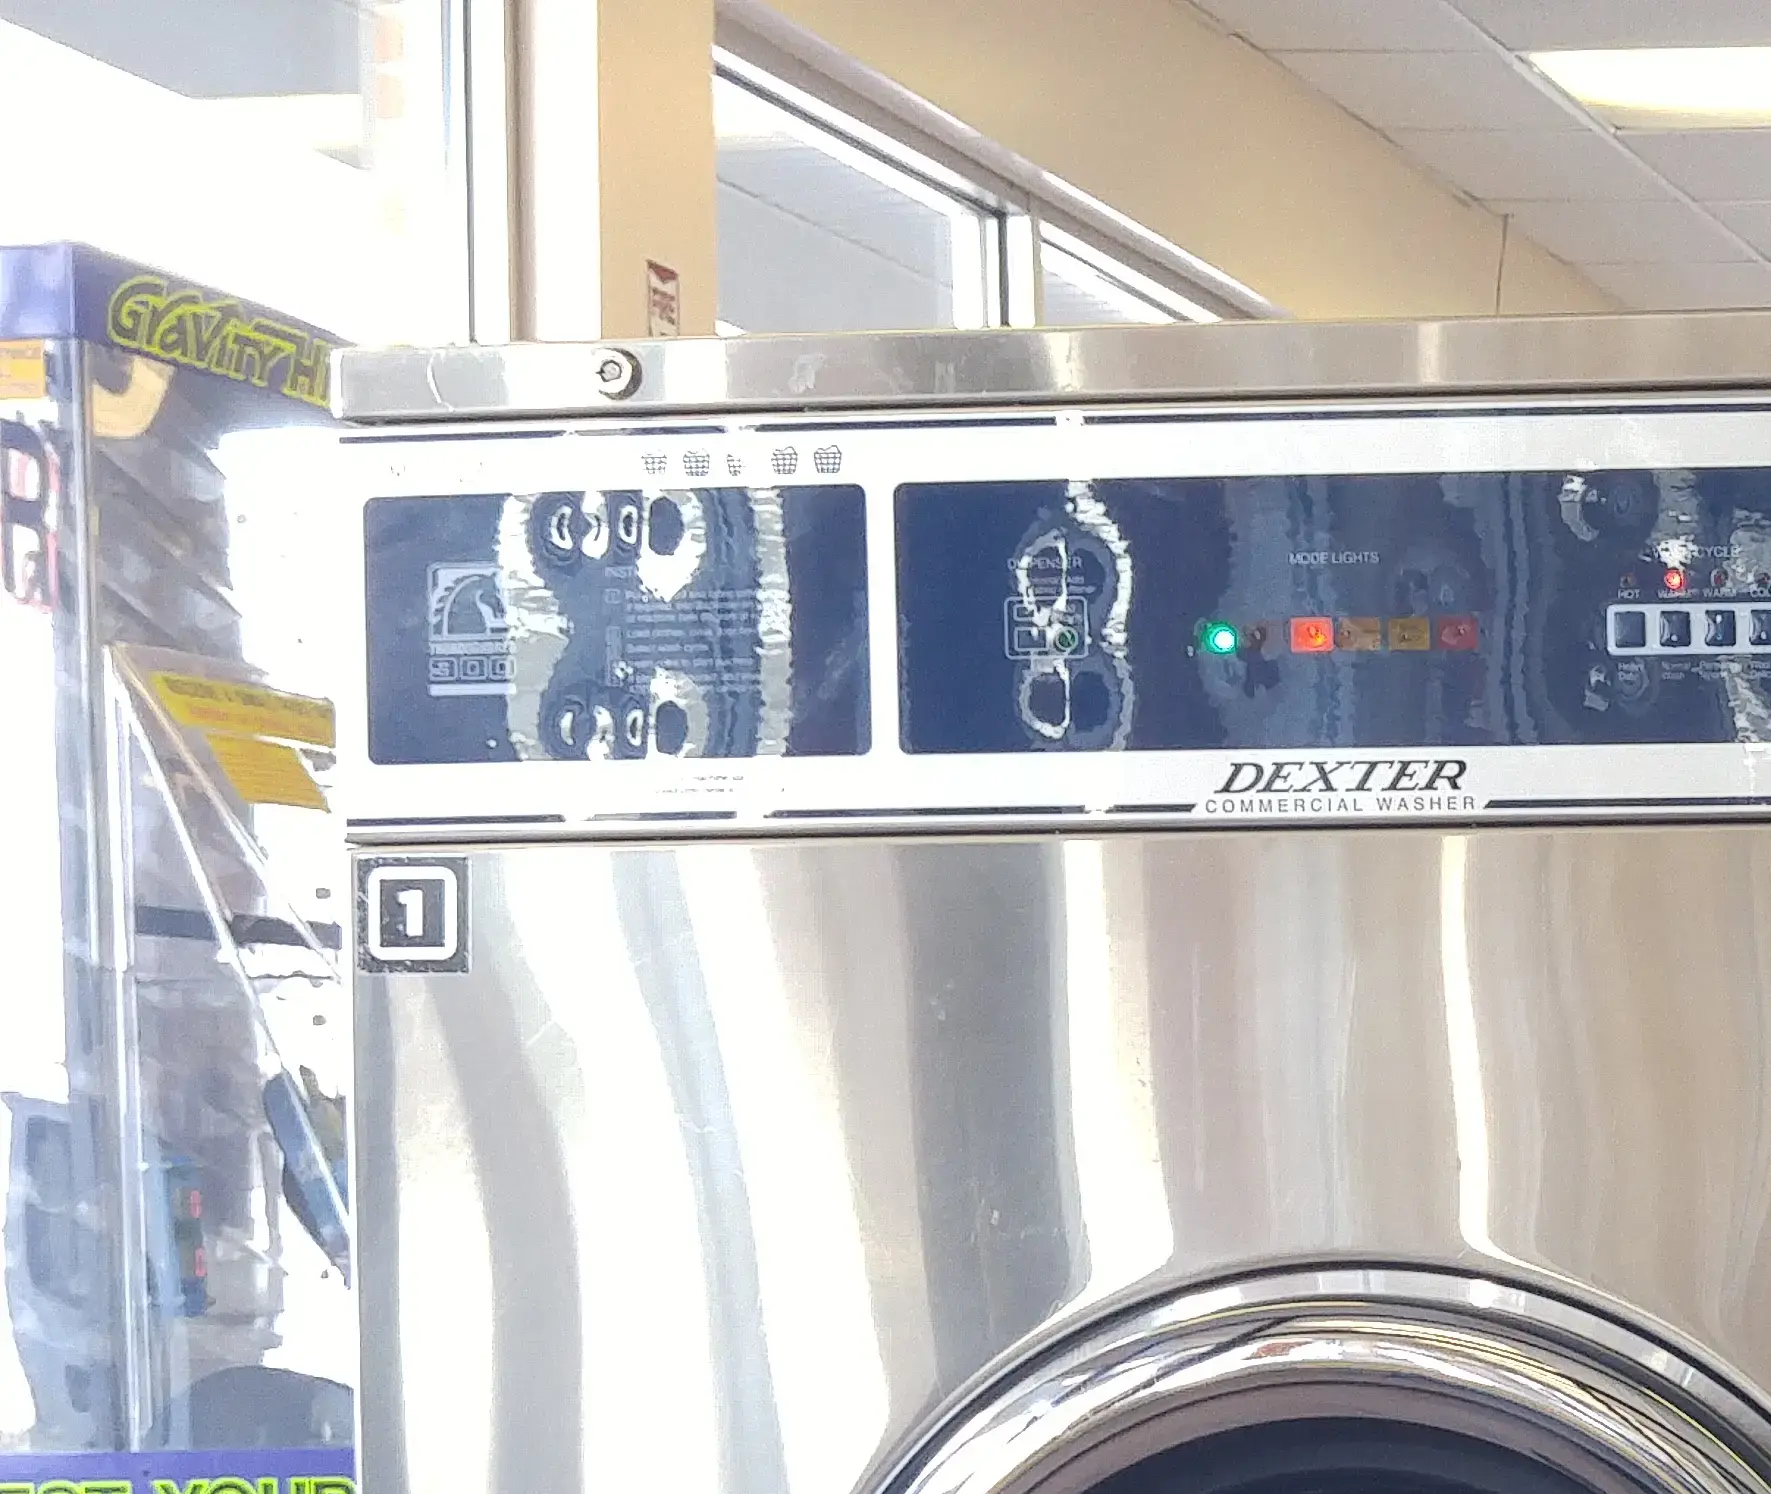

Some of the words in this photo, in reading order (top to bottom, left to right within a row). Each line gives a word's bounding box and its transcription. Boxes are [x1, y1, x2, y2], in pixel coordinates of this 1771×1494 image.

[1287, 551, 1328, 565] MODE
[1331, 551, 1380, 564] LIGHTS
[1213, 759, 1468, 794] DEXTER
[1205, 796, 1364, 814] COMMERCIAL
[1376, 795, 1476, 811] WASHER
[397, 888, 424, 937] 1
